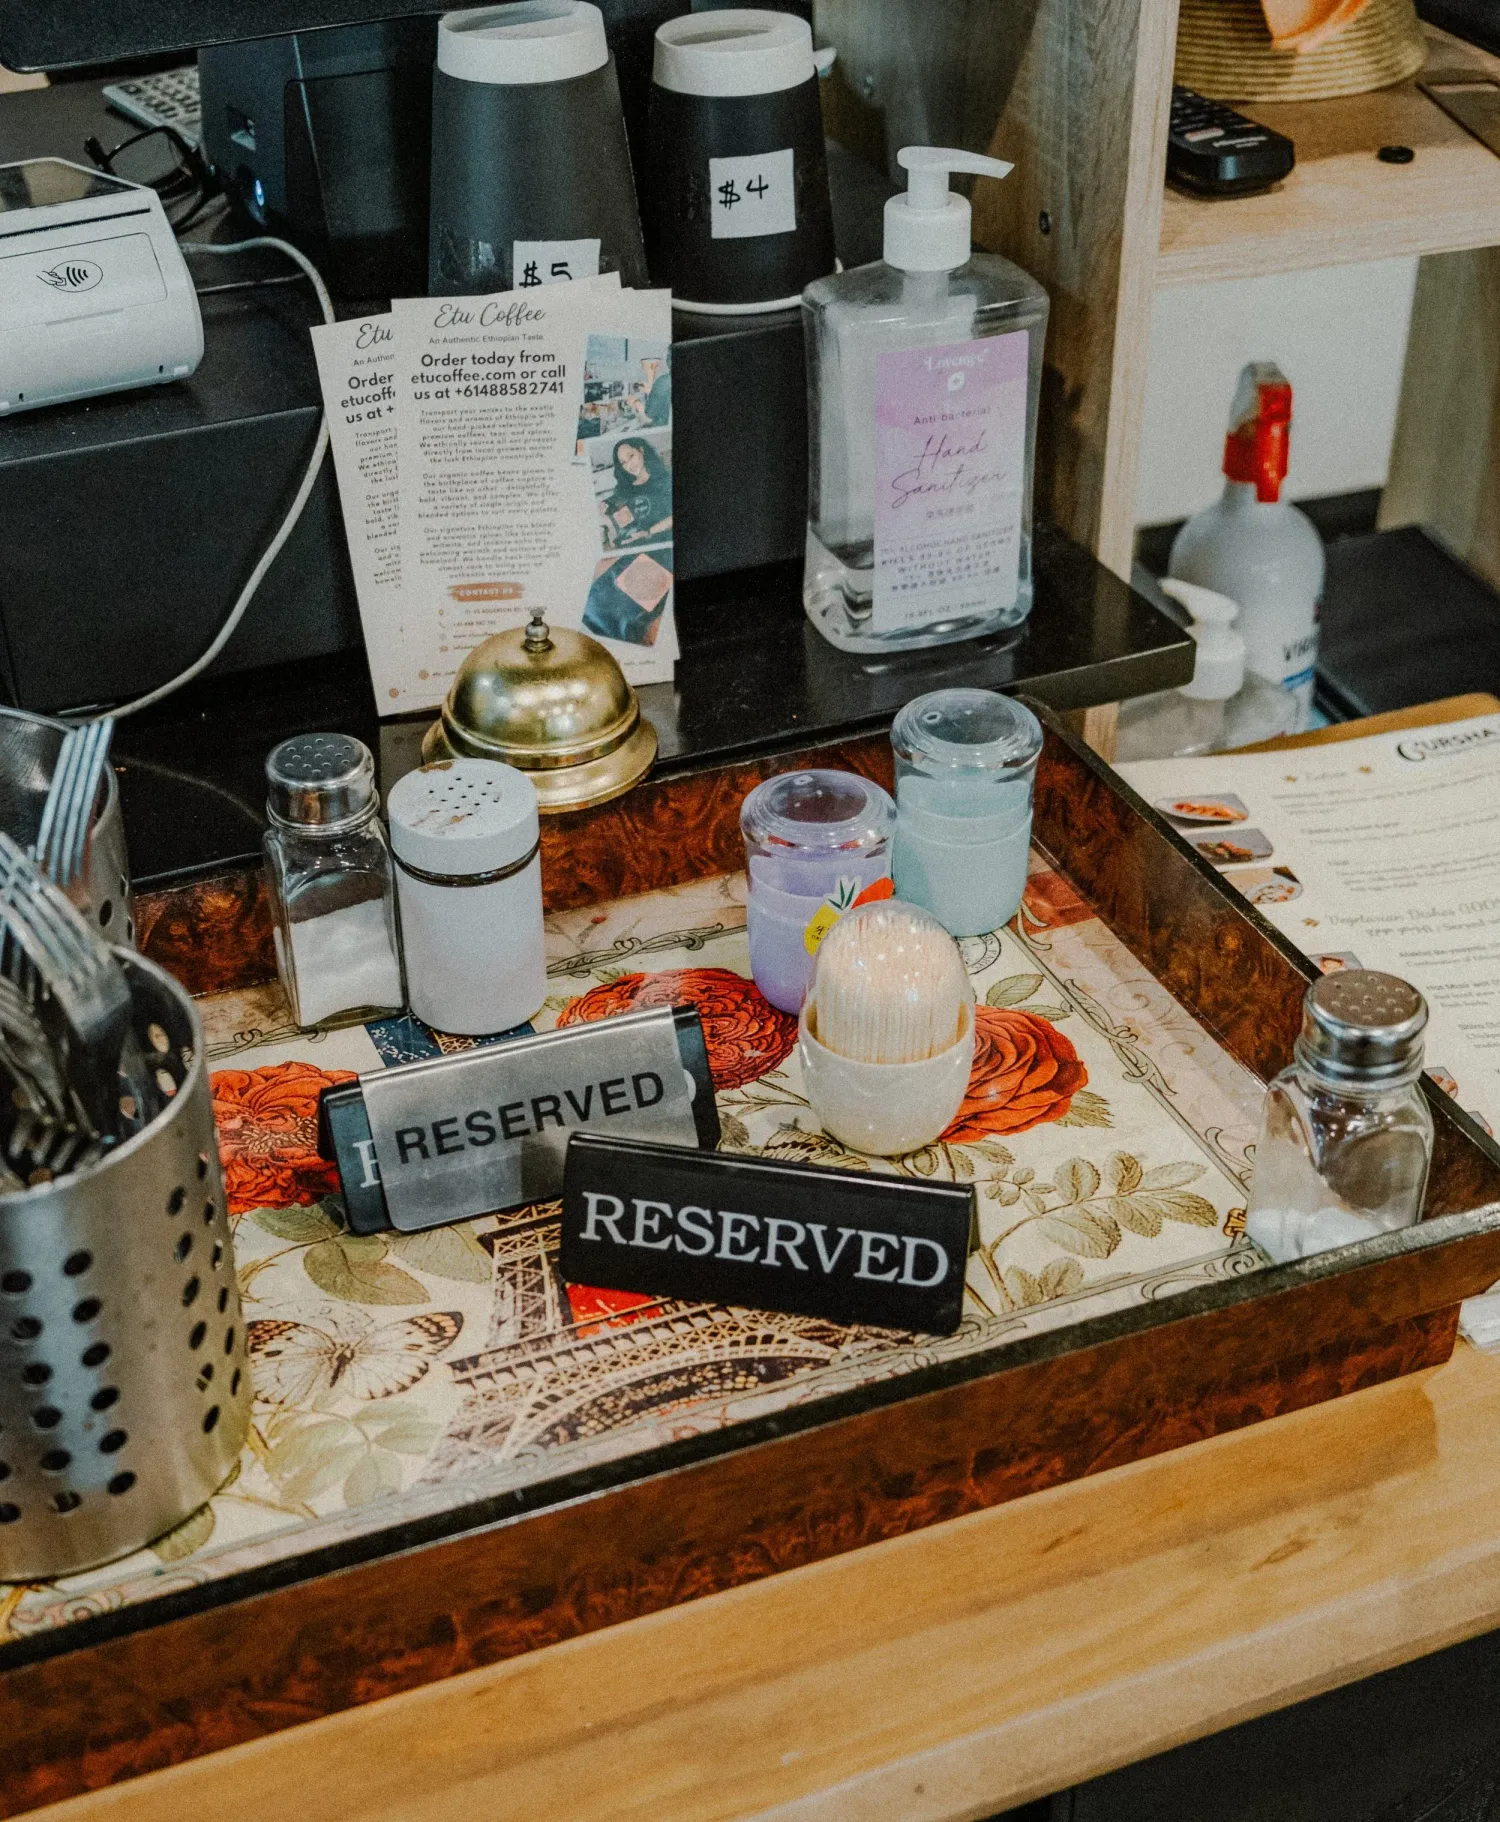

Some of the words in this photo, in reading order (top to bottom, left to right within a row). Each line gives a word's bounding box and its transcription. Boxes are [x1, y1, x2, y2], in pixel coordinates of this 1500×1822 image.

[718, 174, 769, 210] $4
[434, 303, 475, 328] Etu
[480, 302, 546, 327] Coffee
[356, 323, 393, 349] Etu
[443, 336, 479, 344] Authentic
[482, 334, 519, 343] Ethiopian
[421, 353, 467, 366] Order
[472, 351, 514, 367] today
[520, 350, 555, 363] from
[348, 372, 393, 389] Order
[411, 369, 515, 384] etucoffee.com
[521, 371, 536, 380] or
[541, 365, 566, 379] call
[414, 390, 430, 400] us
[435, 388, 450, 399] at
[455, 382, 564, 398] +61488582741
[346, 413, 362, 423] us
[367, 407, 382, 420] at
[914, 430, 988, 480] Hand
[396, 1069, 665, 1167] RESERVED
[579, 1191, 951, 1290] RESERVED
